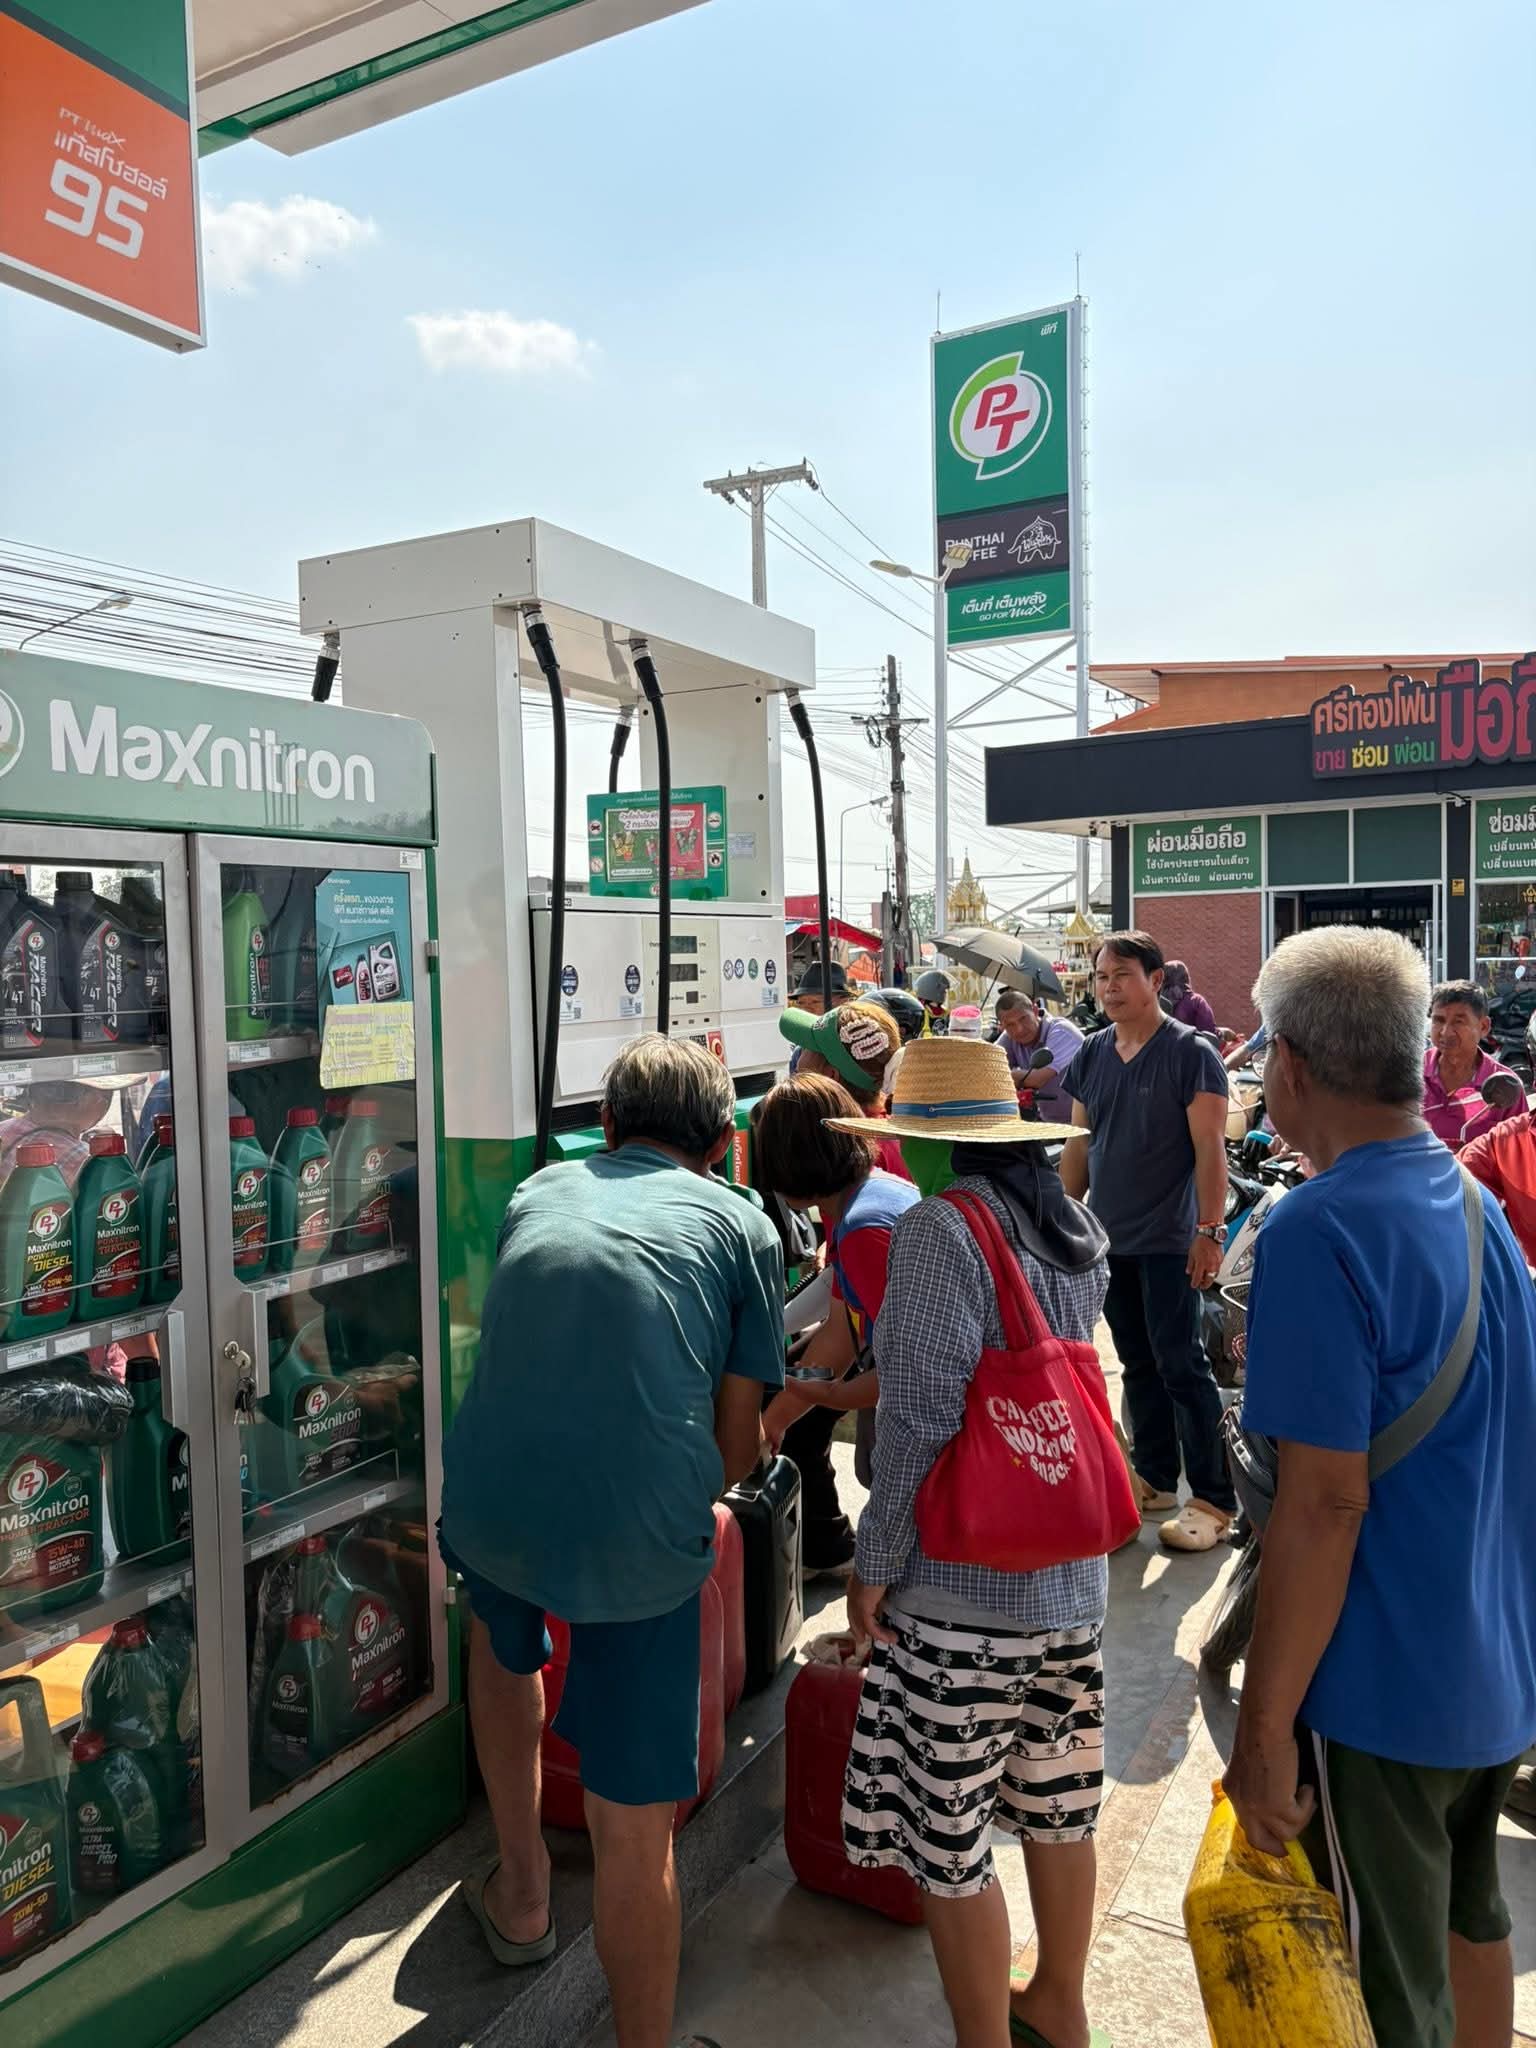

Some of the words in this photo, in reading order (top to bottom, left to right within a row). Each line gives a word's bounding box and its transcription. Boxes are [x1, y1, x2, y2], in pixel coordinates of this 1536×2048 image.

[59, 106, 80, 125] PT
[54, 130, 168, 200] แก๊สโซฮอล์
[44, 158, 148, 260] 95
[974, 383, 1030, 451] PT
[1314, 680, 1436, 736] ศรีทองโฟน
[49, 699, 375, 802] Maxnitron
[1315, 749, 1346, 773] ขาย
[1352, 739, 1389, 769] ซ่อม
[1394, 736, 1435, 765] ผ่อน
[1147, 823, 1247, 853] ผ่อนมือถือ
[27, 1239, 72, 1255] Maxnitron
[97, 1224, 140, 1239] Maxnitron
[34, 1255, 73, 1272] DIESEL
[299, 1408, 361, 1439] Maxnitron
[18, 1471, 40, 1497] PT
[0, 1494, 89, 1533] Maxnitron
[351, 1626, 406, 1671] Maxnitron
[97, 1853, 118, 1865] PRO
[3, 1858, 55, 1902] DIESEL
